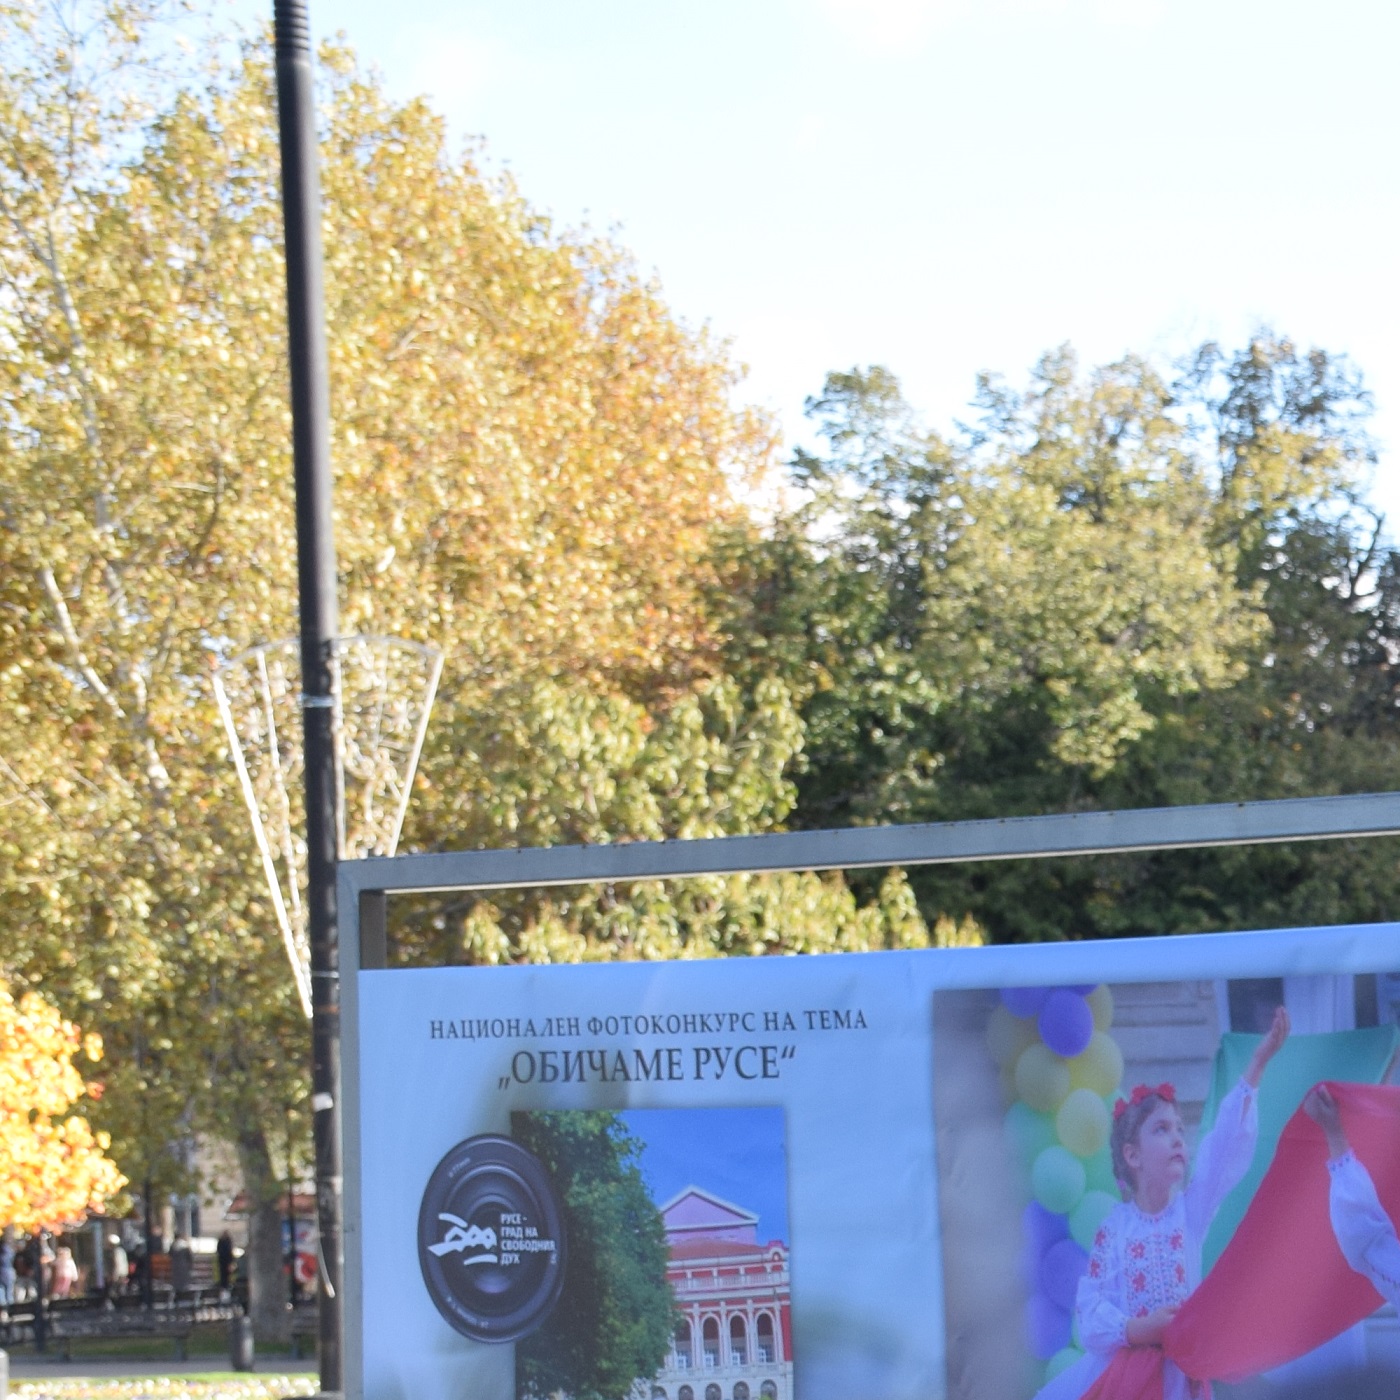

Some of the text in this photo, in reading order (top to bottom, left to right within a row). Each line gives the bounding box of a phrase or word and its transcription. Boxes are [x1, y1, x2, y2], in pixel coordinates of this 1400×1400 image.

[429, 1009, 868, 1042] НАЦИОНАЛЕН ФОТОКОНКУРС НА ТЕМА
[498, 1045, 796, 1090] „ОБИЧАМЕ РУСЕ“
[501, 1213, 521, 1225] РУСЕ
[501, 1226, 538, 1239] ГРАД НА
[501, 1240, 556, 1252] СВОБОДНИЯ
[501, 1253, 520, 1265] ДУХ
